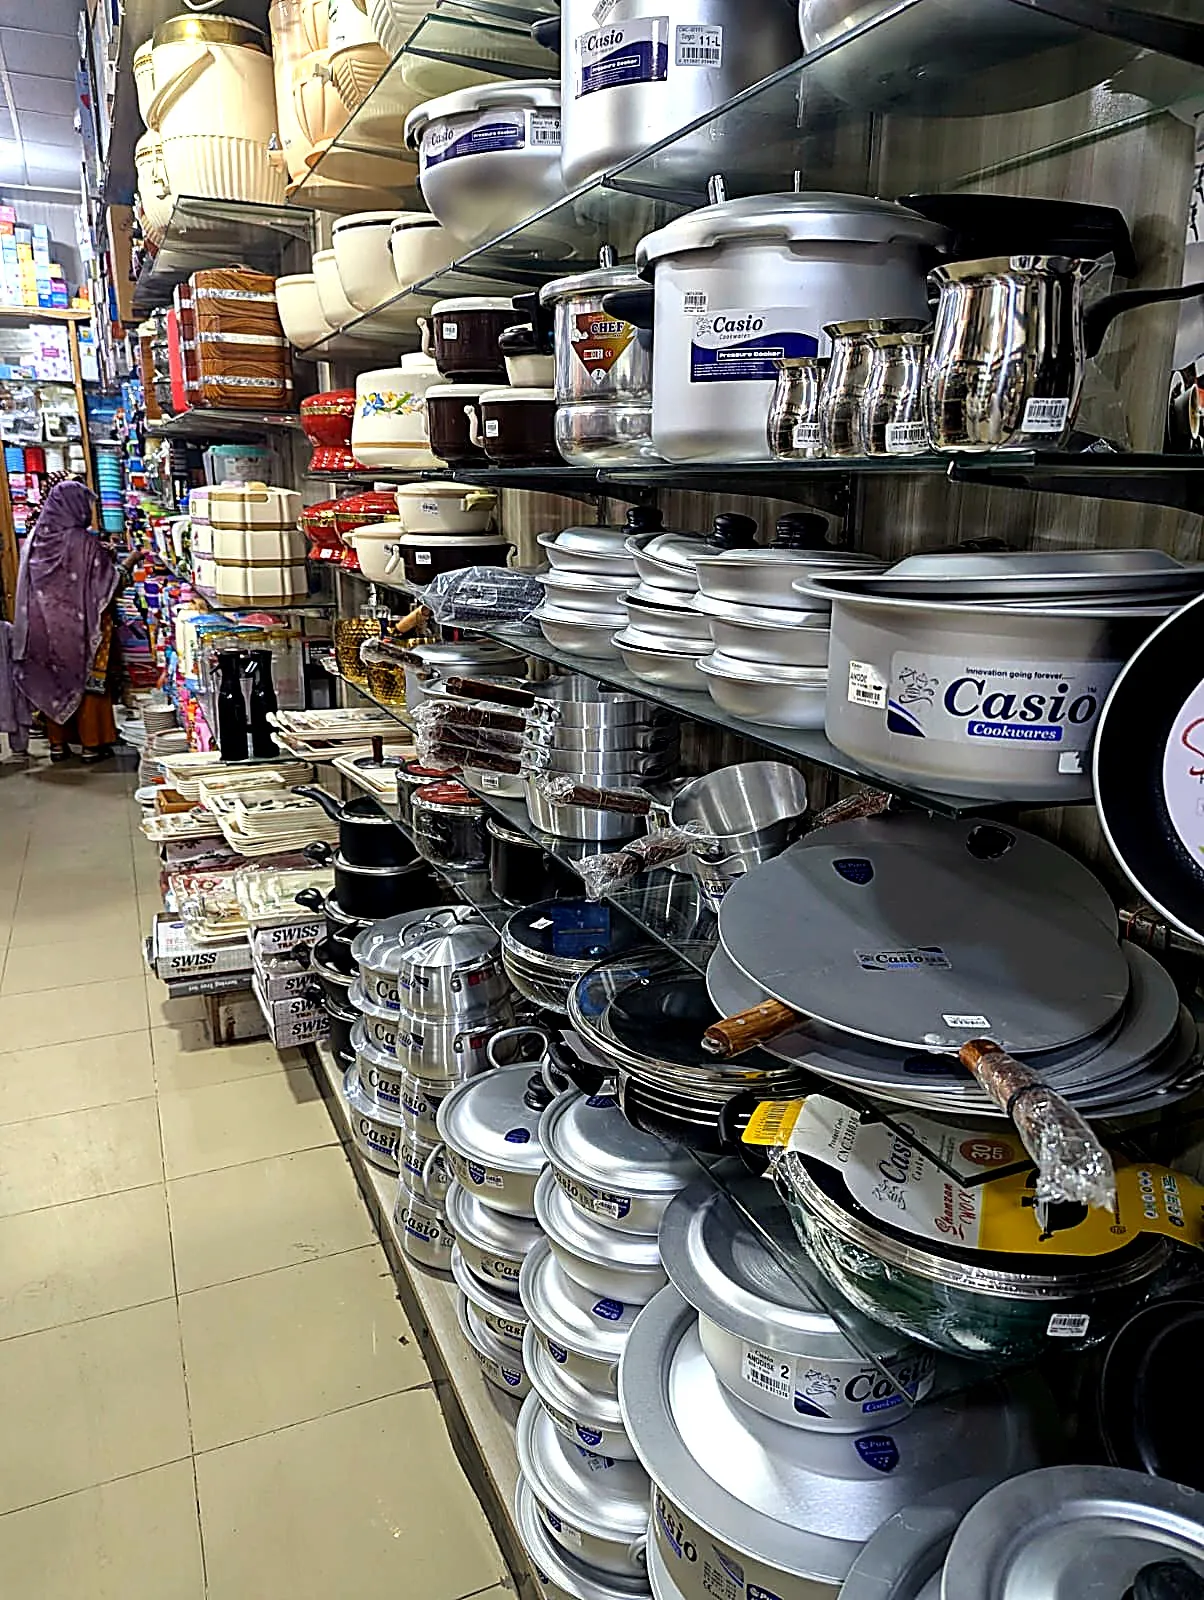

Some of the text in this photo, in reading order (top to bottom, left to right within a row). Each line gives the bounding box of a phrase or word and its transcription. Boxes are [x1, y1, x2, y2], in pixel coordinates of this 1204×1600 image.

[587, 29, 624, 52] Casio
[591, 321, 625, 334] CHEF
[713, 314, 764, 333] Casio
[753, 350, 781, 358] Cooker
[966, 667, 1008, 678] Innovation
[1009, 670, 1032, 681] going
[944, 677, 1097, 725] Casio
[973, 723, 1057, 740] Cookwares
[272, 925, 320, 943] SWISS
[171, 952, 217, 968] SWISS
[876, 953, 924, 964] Casio
[285, 973, 315, 991] SWI
[291, 1018, 331, 1036] SWIS
[368, 1069, 401, 1096] Cas
[403, 1091, 427, 1113] asio
[401, 1144, 425, 1170] Casi
[971, 1144, 992, 1160] 30
[935, 1183, 953, 1236] Shanzan
[401, 1207, 440, 1239] Casio
[494, 1260, 520, 1277] Cas
[497, 1317, 524, 1337] Casi
[780, 1364, 790, 1380] 2
[657, 1492, 698, 1563] asio
